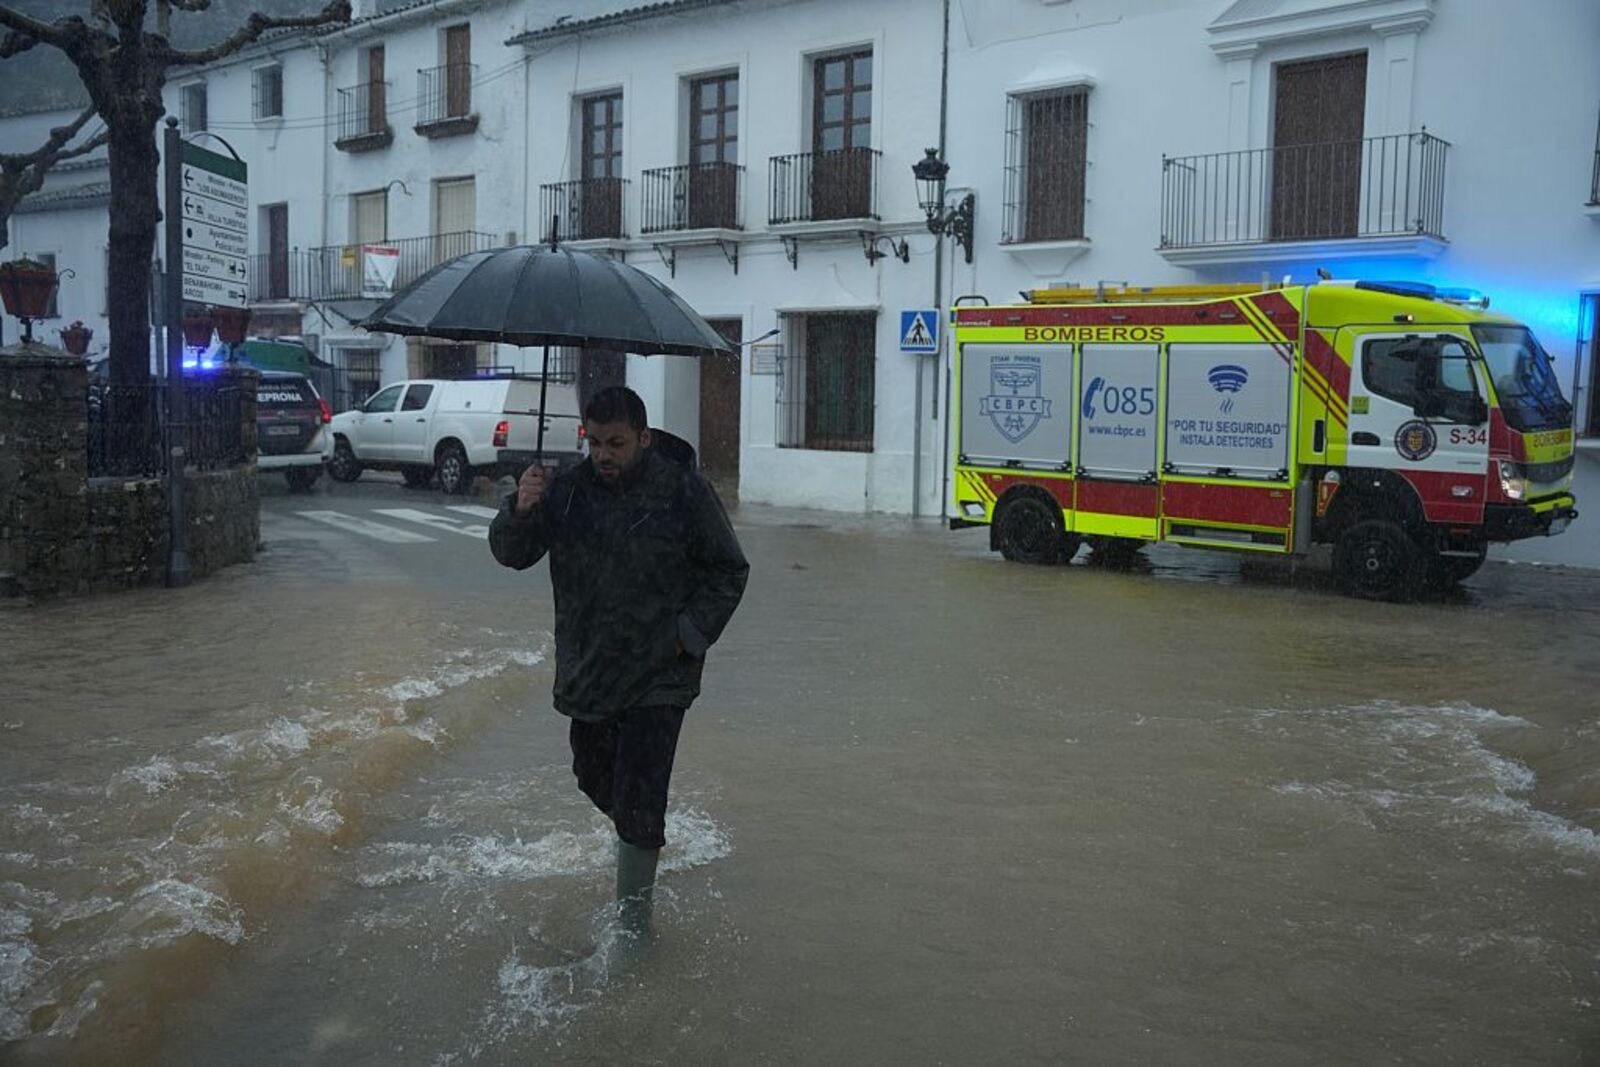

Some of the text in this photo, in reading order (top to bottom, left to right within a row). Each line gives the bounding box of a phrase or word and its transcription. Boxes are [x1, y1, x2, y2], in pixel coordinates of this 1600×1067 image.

[1024, 327, 1165, 341] BOMBEROS
[257, 392, 303, 402] EPRONA
[1104, 386, 1154, 415] 085
[1088, 424, 1146, 438] www.cbpc.es
[1200, 420, 1213, 432] TU
[1180, 433, 1274, 449] INSTALA DETECTORES
[1450, 428, 1487, 445] S-34
